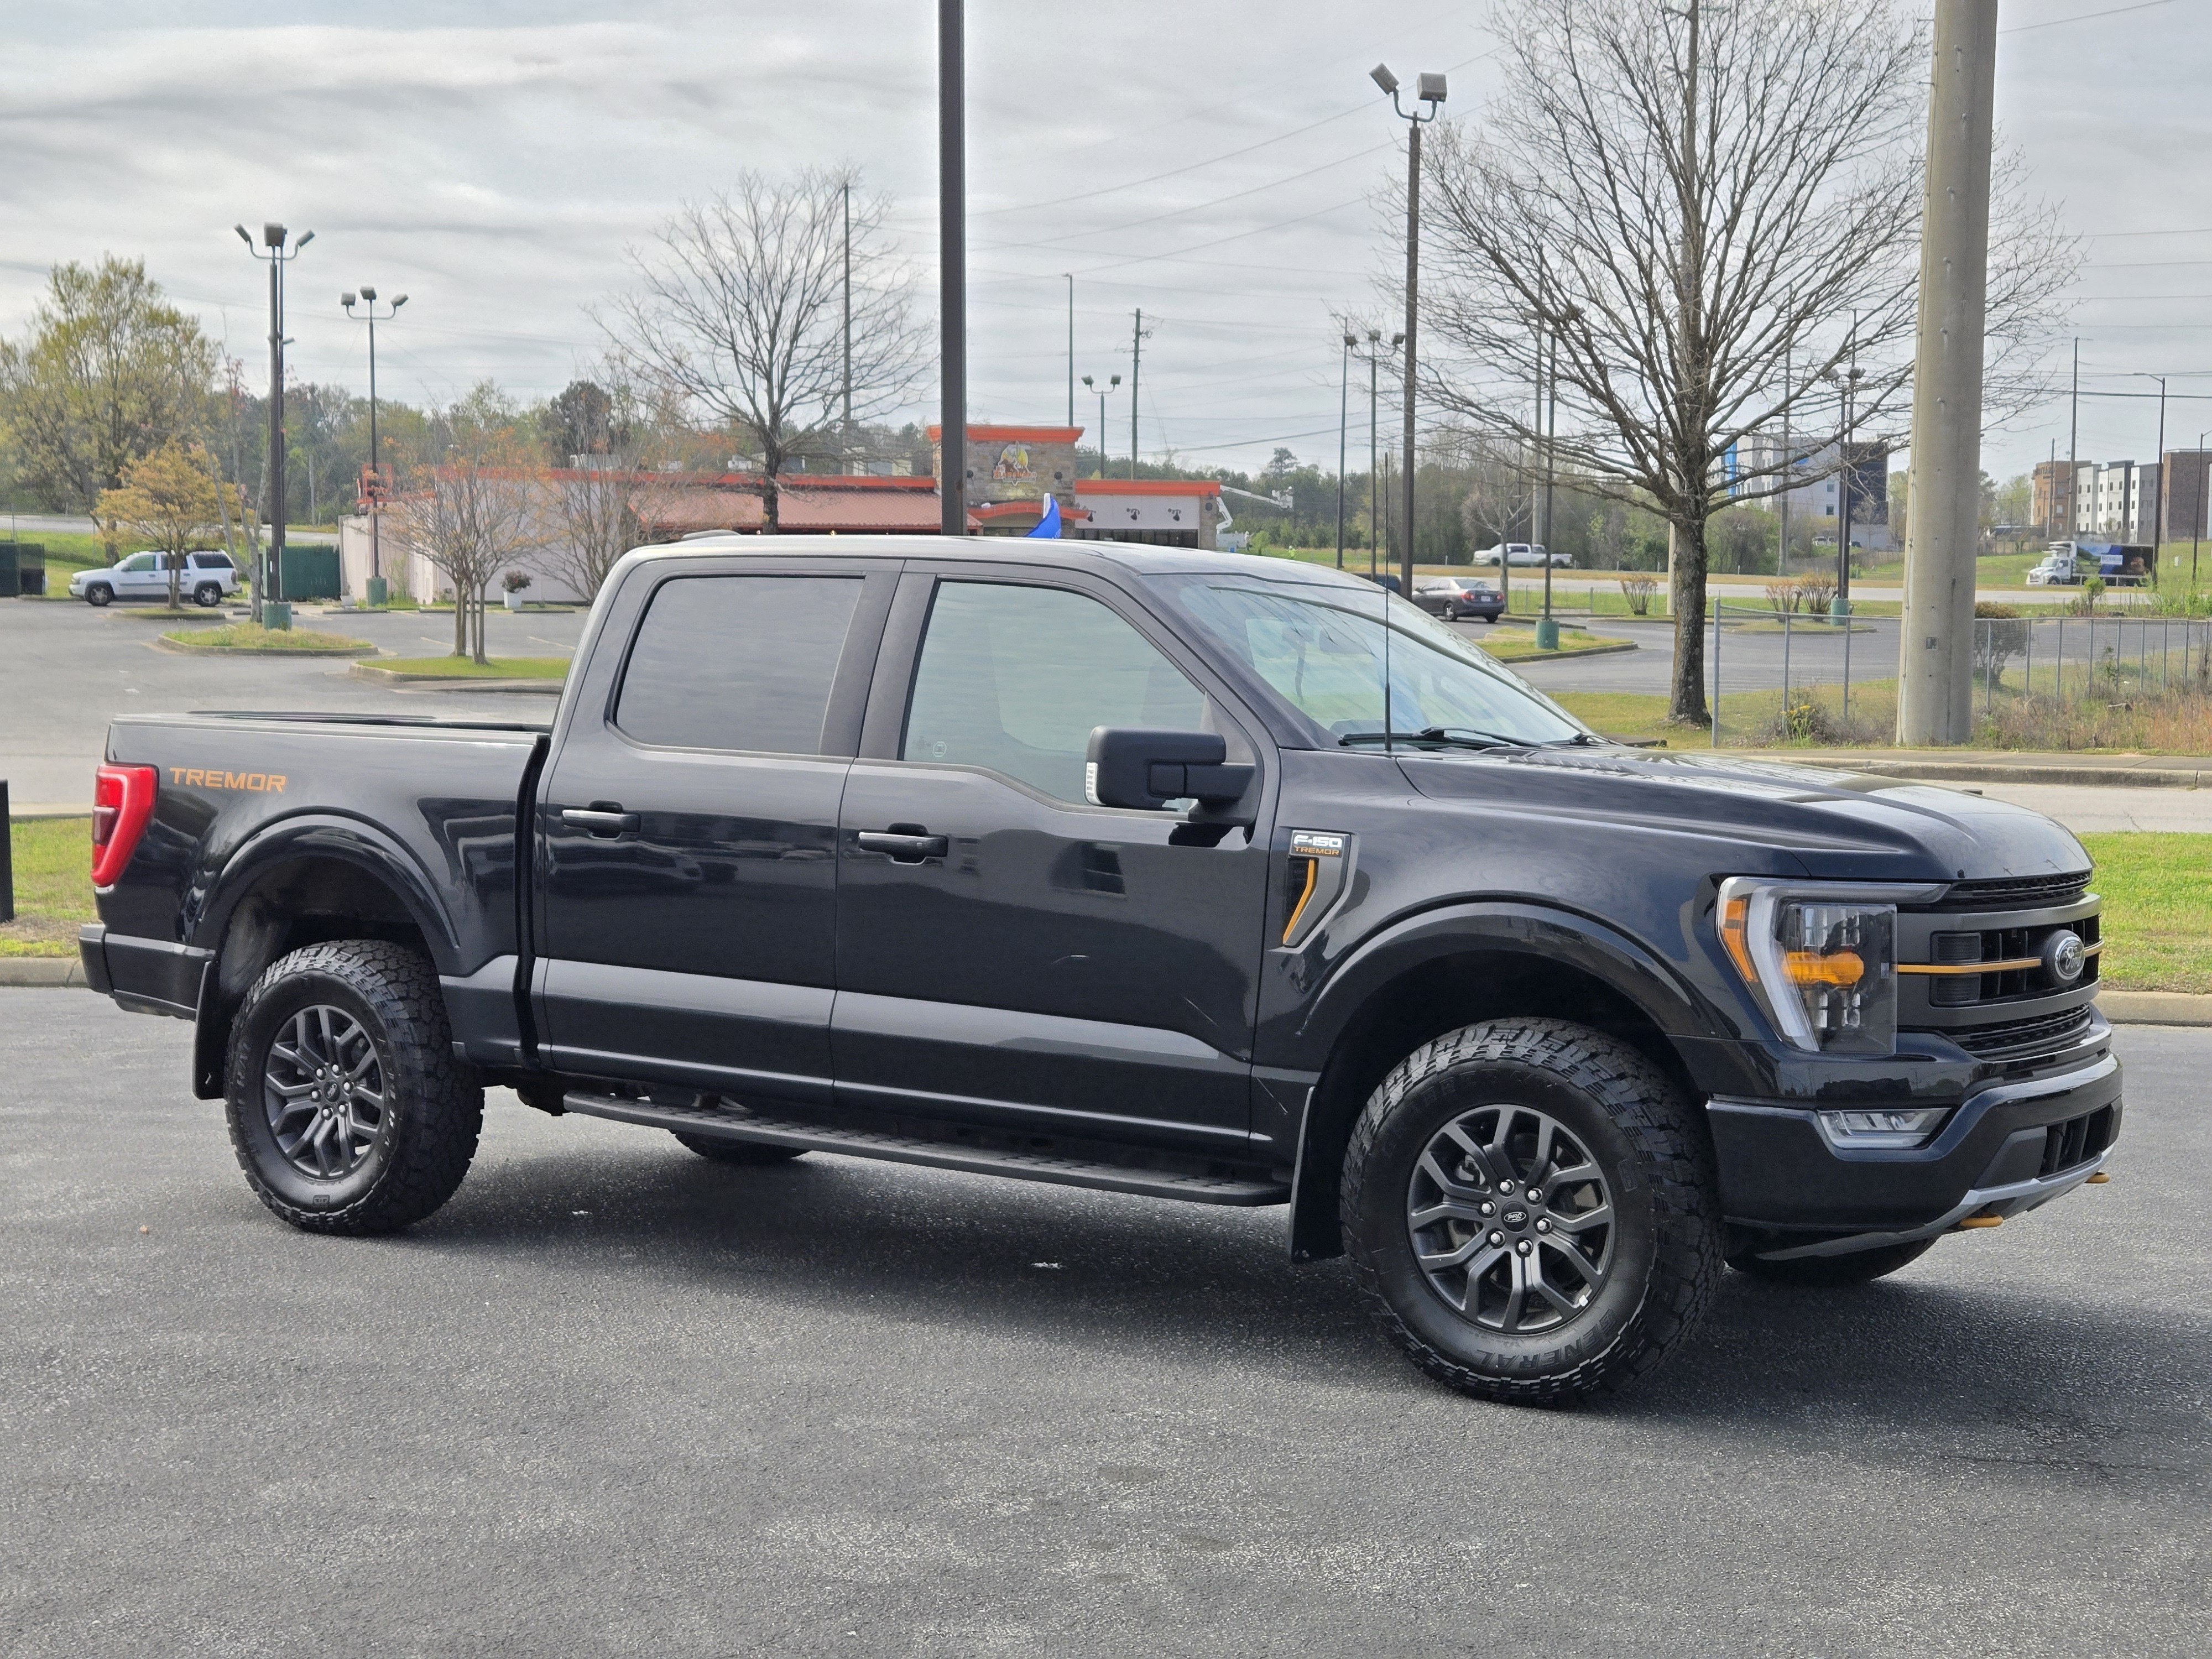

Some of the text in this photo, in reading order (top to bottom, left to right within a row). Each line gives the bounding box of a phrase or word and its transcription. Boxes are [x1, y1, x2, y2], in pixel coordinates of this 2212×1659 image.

[169, 767, 287, 792] TREMOR
[1293, 834, 1343, 848] F-150
[1293, 846, 1340, 855] TREMOR
[1477, 1308, 1617, 1370] GENERAL
